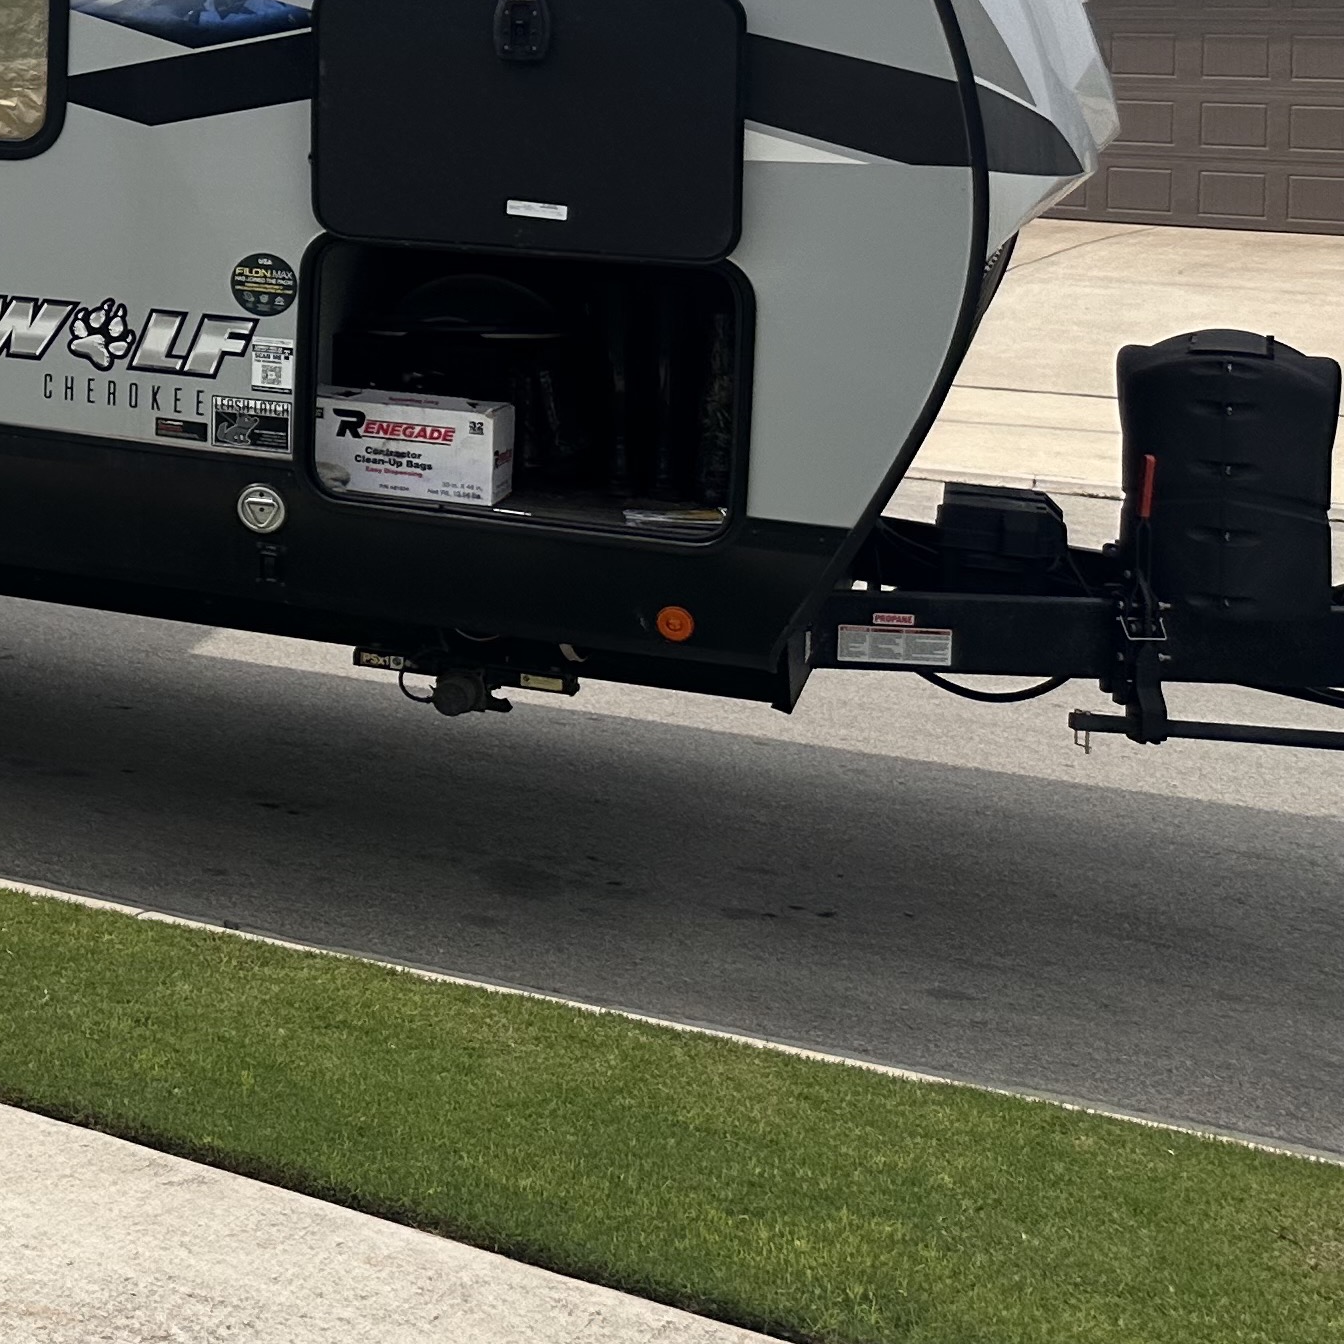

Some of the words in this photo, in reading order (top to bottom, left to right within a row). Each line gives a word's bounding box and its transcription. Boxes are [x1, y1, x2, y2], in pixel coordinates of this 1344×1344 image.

[235, 267, 271, 278] FILON
[272, 269, 293, 279] MAX
[43, 372, 205, 416] CHEROKEE
[332, 408, 455, 443] RENEGADE
[364, 445, 422, 460] Contractor
[354, 454, 403, 468] Clean-Up
[406, 460, 433, 471] Bags
[874, 614, 913, 623] PROPANE
